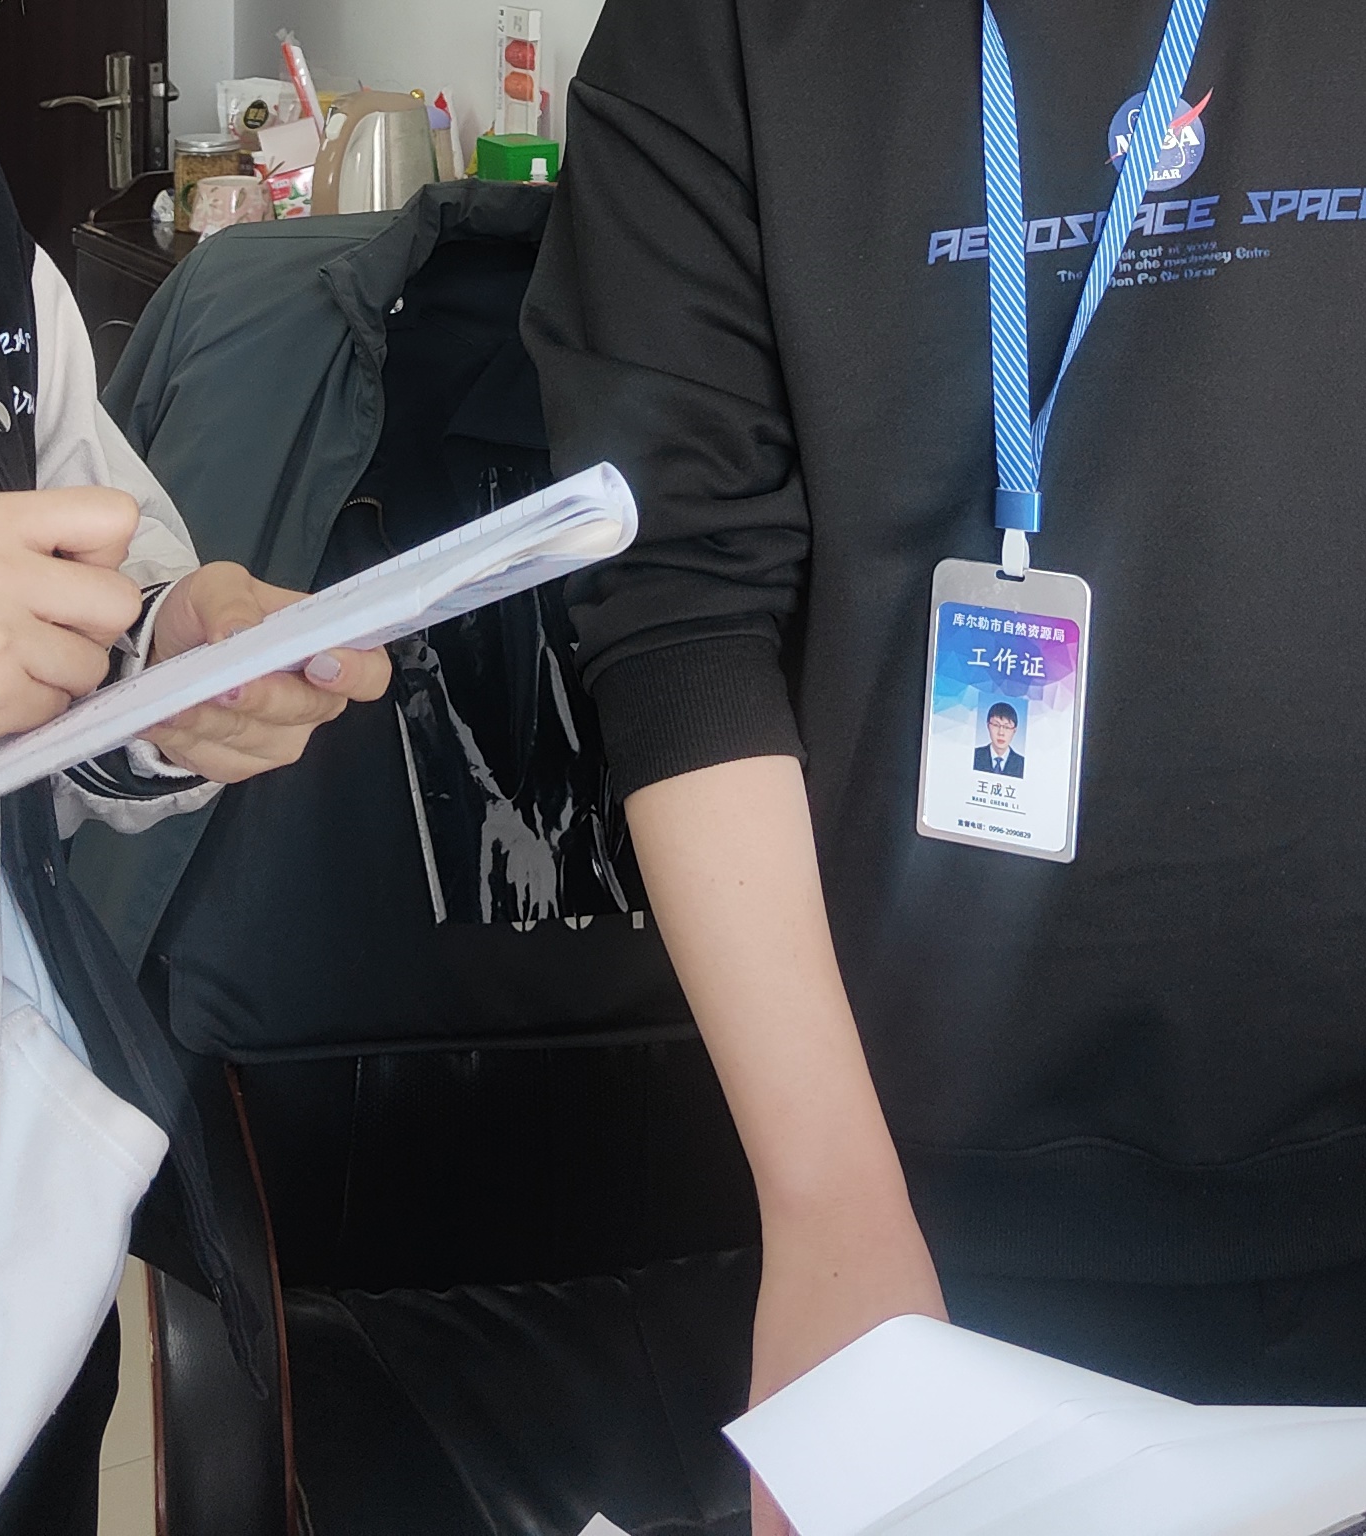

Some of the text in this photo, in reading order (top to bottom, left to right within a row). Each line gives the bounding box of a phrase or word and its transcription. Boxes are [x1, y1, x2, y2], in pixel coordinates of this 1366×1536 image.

[952, 612, 1065, 643] 库尔勒市自然资源局
[967, 648, 1046, 678] 工作证
[977, 780, 1016, 799] 王成立
